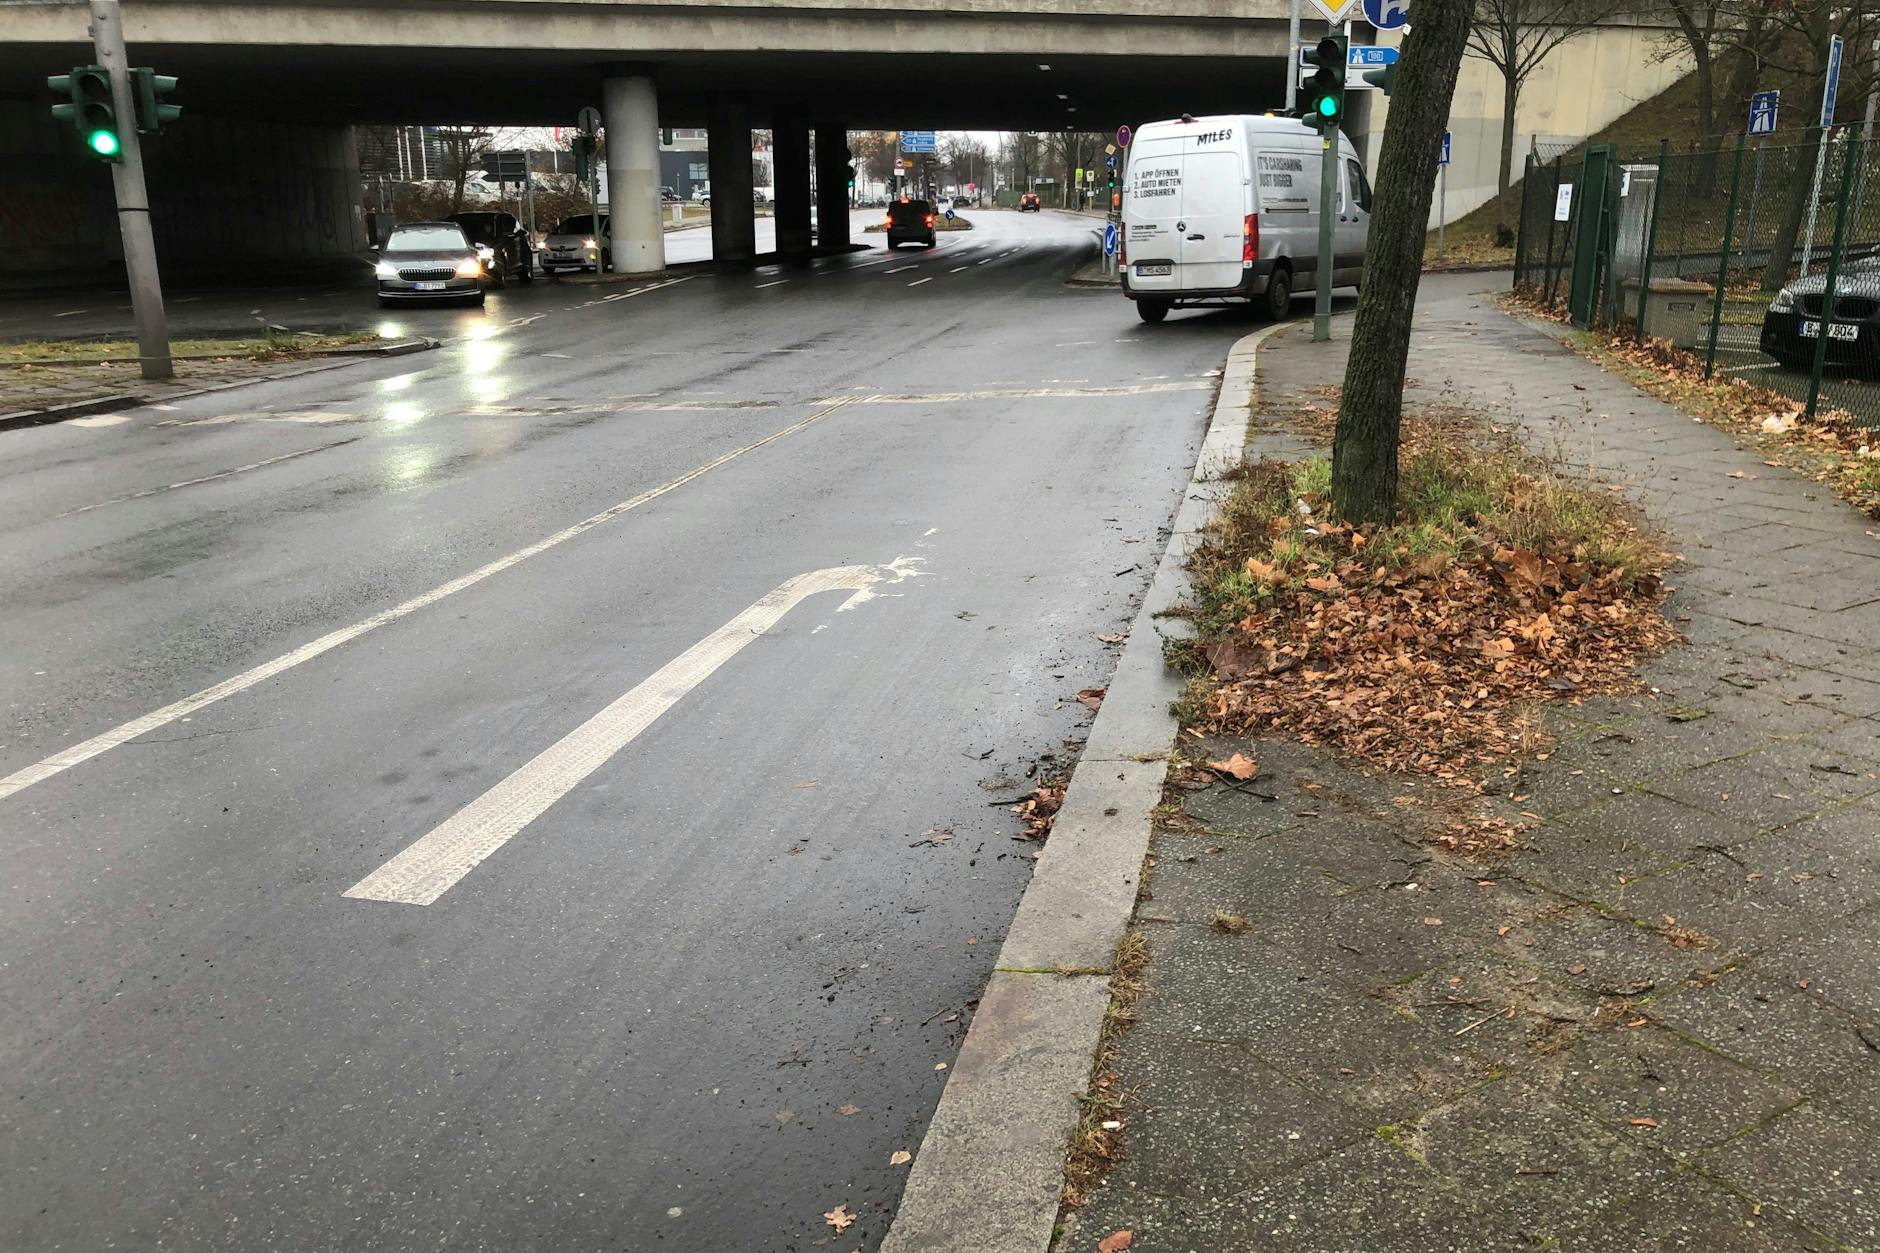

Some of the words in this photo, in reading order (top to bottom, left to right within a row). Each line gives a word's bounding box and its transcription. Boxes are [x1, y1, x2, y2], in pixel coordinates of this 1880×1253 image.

[1197, 129, 1232, 146] MILES
[1269, 157, 1303, 172] CARSHARING
[1141, 170, 1154, 179] APP
[1155, 168, 1179, 178] ÖFFNEN
[1141, 180, 1157, 189] AUTO
[1158, 178, 1182, 187] MIETEN
[1140, 188, 1176, 198] LOSFAHREN
